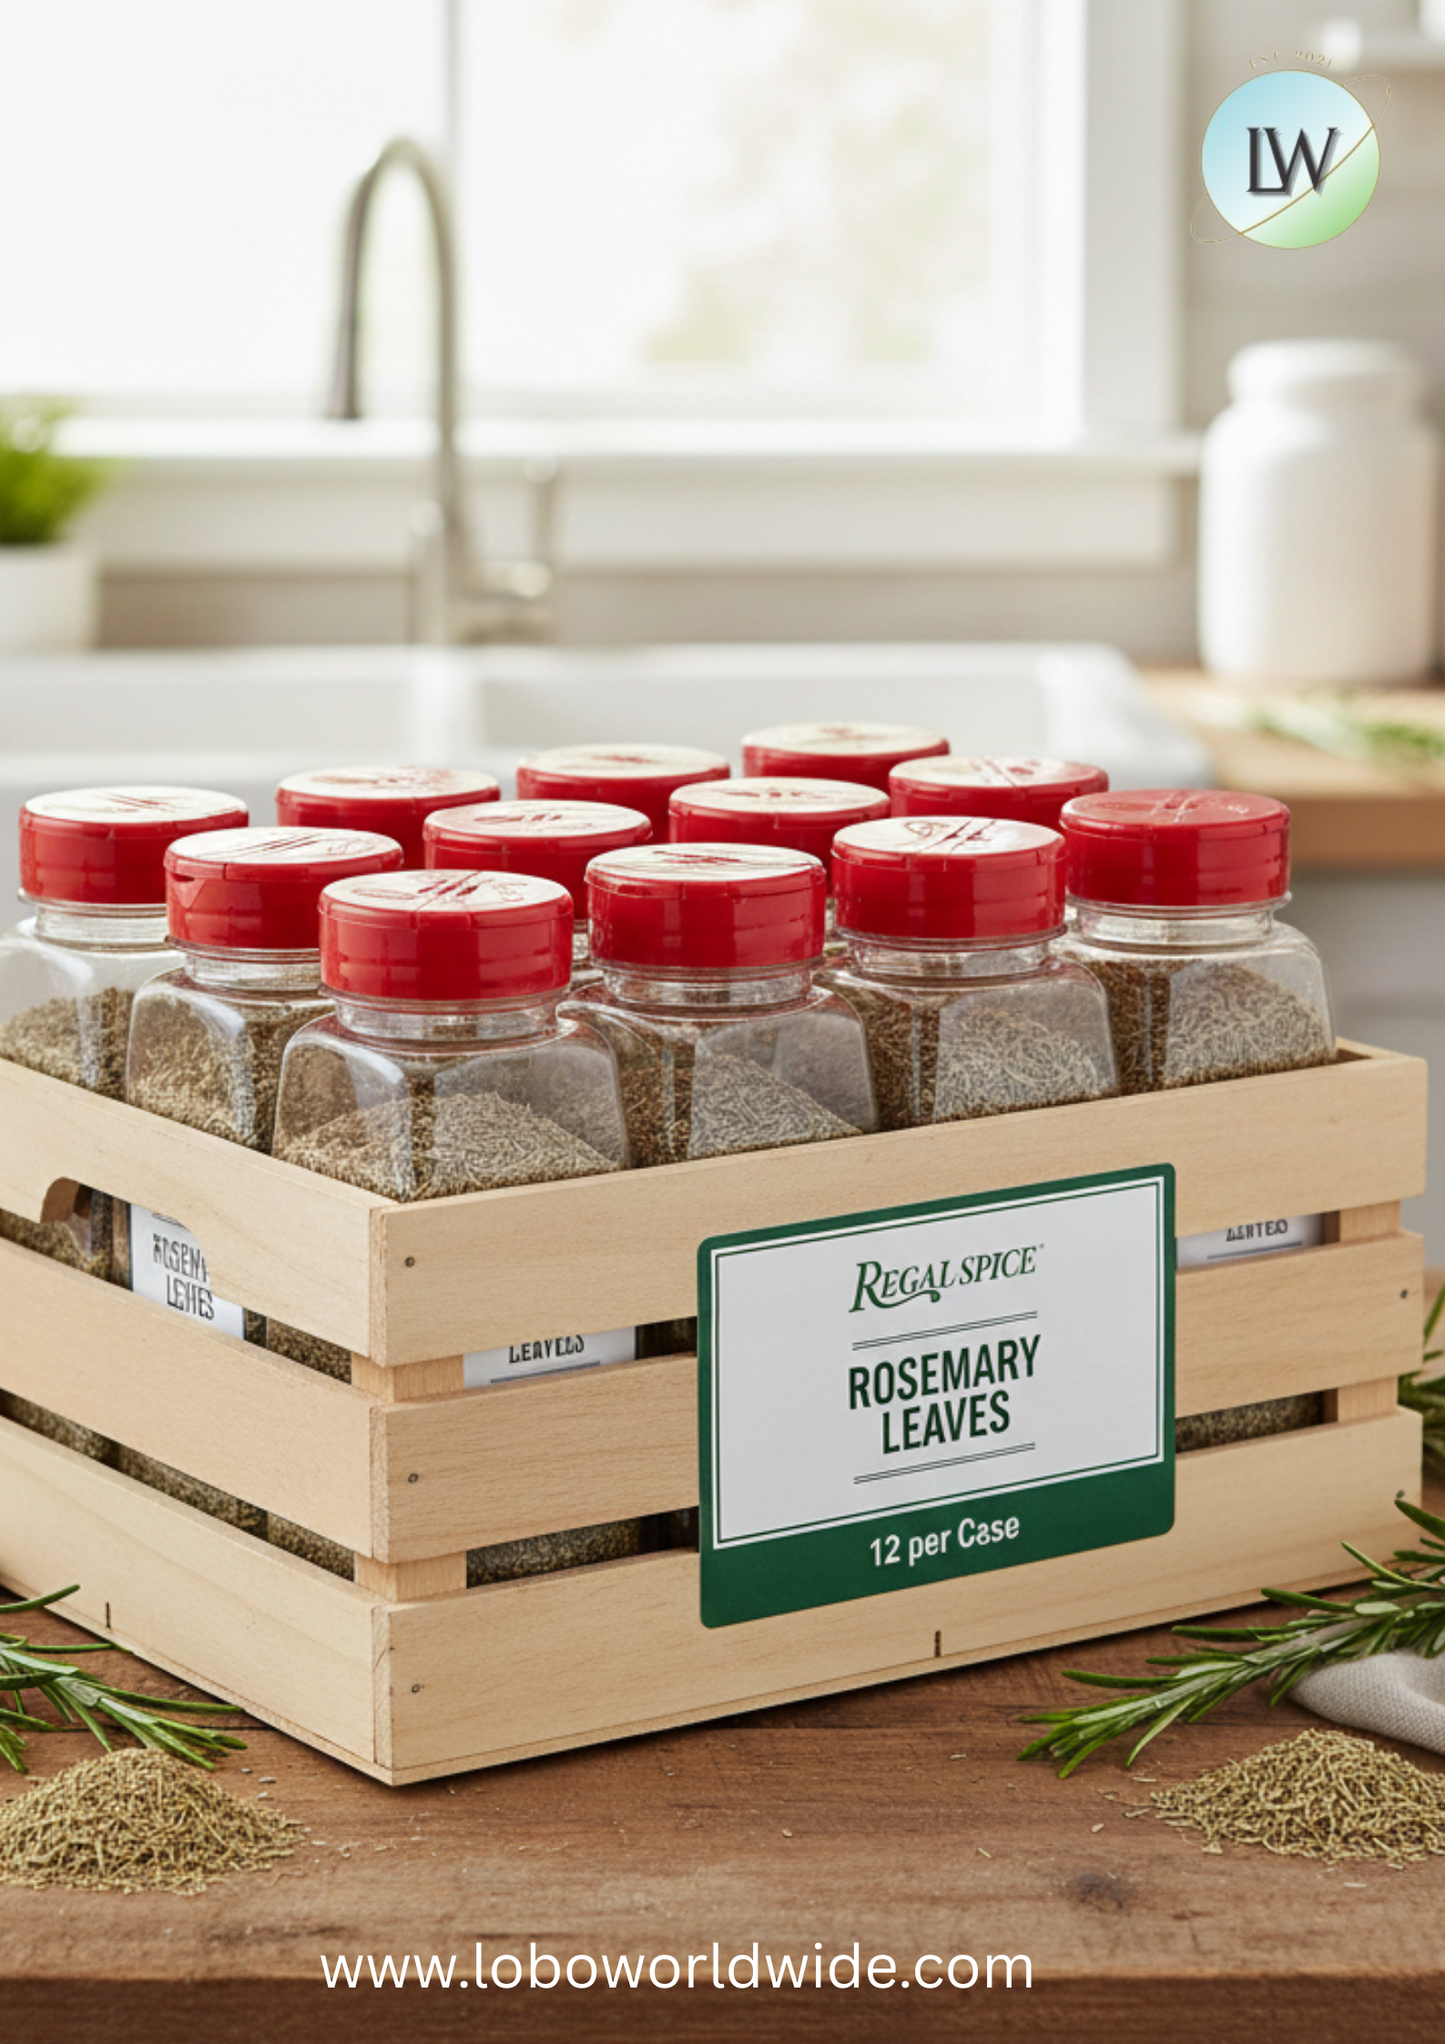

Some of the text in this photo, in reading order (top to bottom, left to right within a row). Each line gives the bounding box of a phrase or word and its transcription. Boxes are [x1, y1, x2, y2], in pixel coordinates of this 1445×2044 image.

[848, 1247, 1038, 1313] REGAL SPICE
[848, 1334, 1041, 1410] ROSEMARY
[881, 1389, 1011, 1455] LEAVES
[869, 1514, 1021, 1567] 12 per Case
